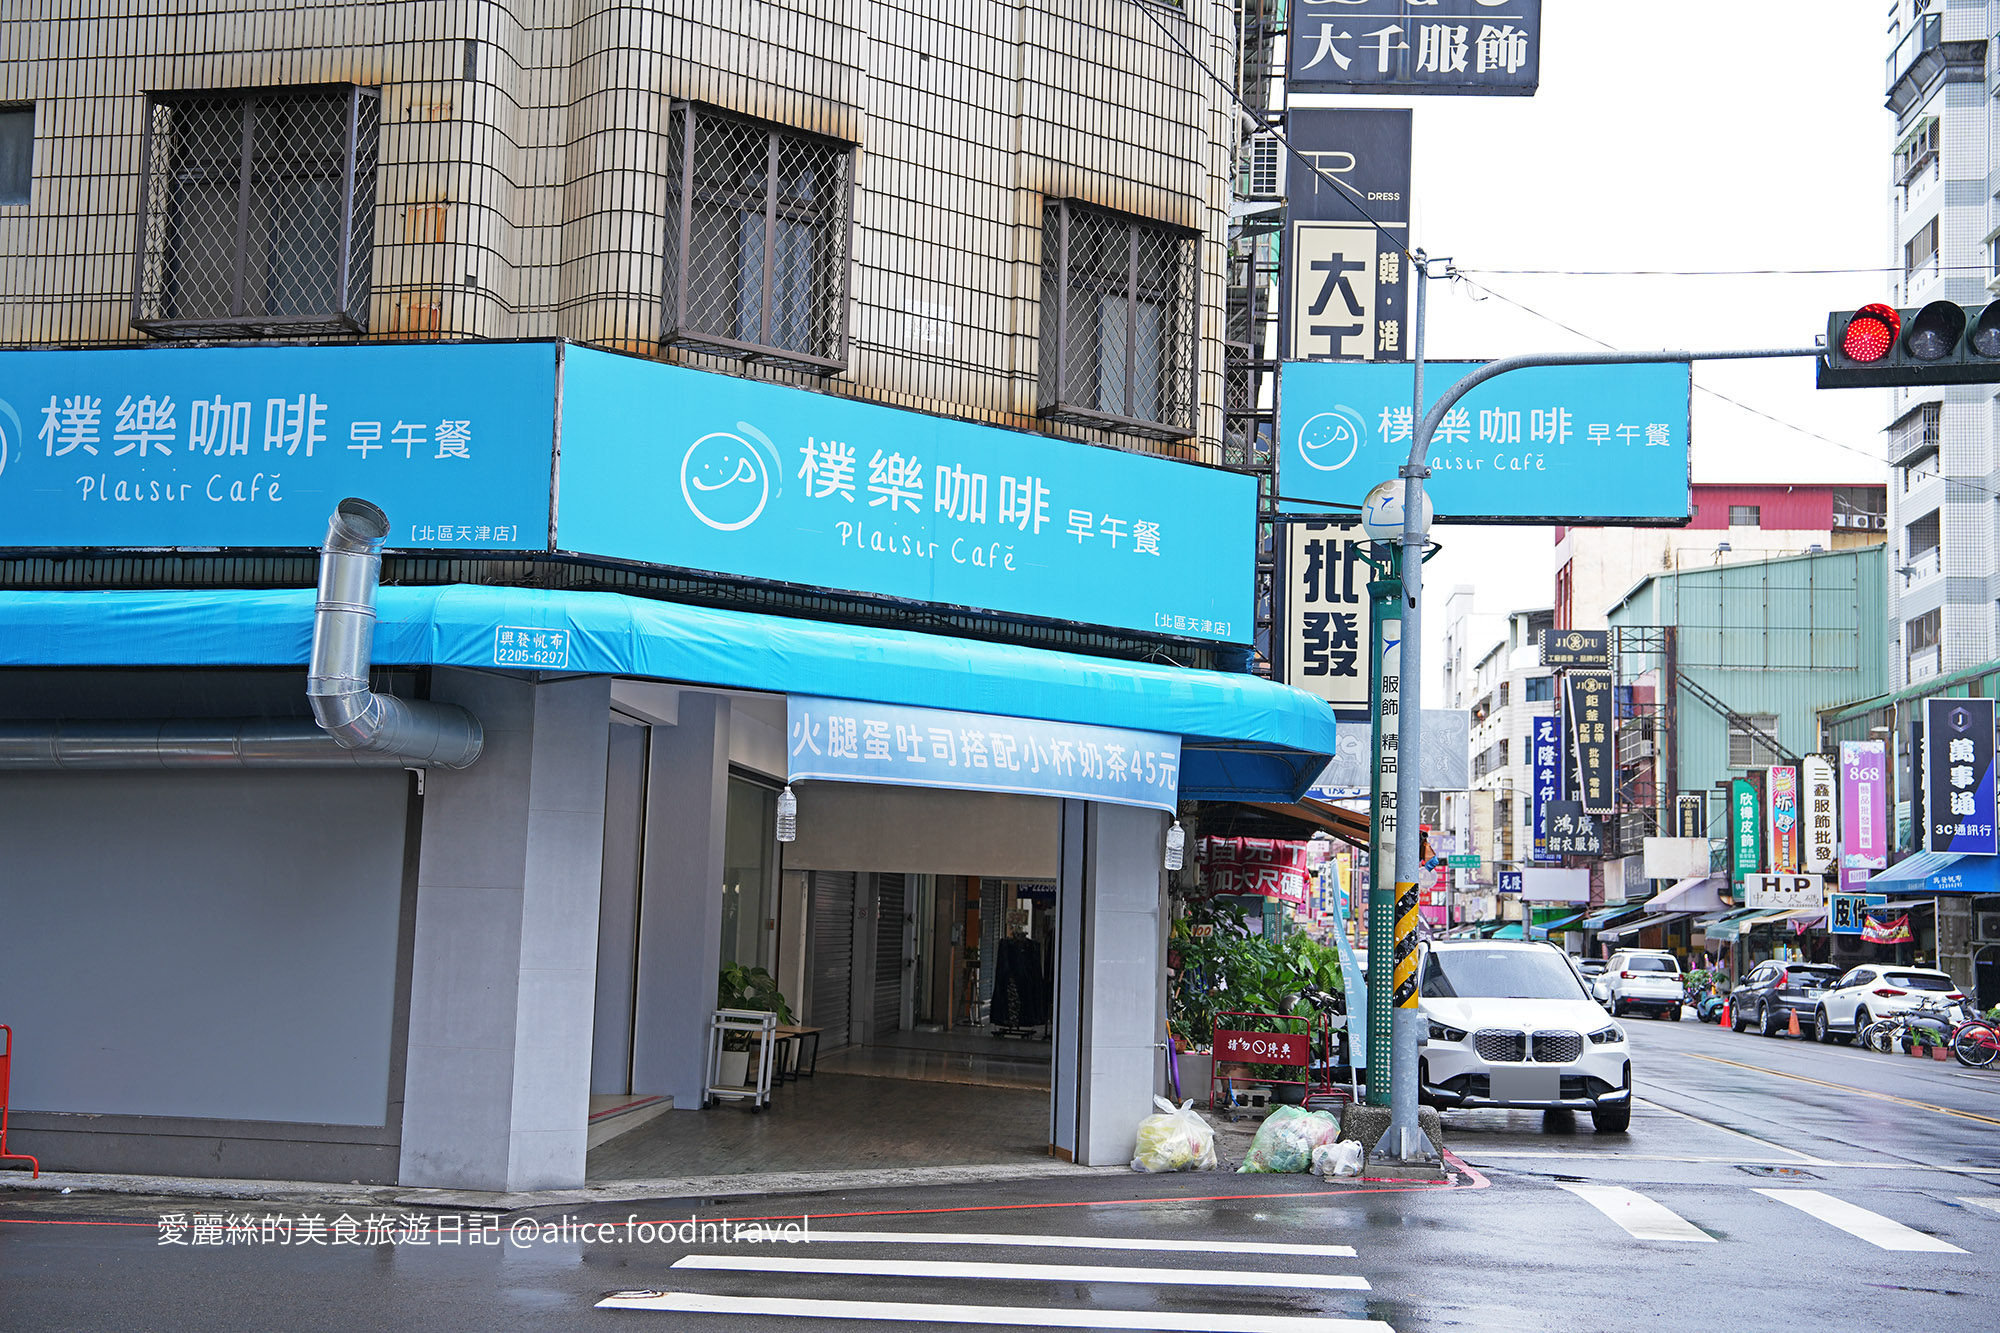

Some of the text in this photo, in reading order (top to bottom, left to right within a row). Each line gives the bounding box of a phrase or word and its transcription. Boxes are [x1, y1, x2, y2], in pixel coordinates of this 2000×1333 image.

[1300, 22, 1529, 74] 大千服飾
[1297, 150, 1366, 199] R
[1367, 191, 1401, 201] DRESS
[37, 393, 472, 461] 樸樂咖啡 早午餐
[1376, 405, 1672, 448] 樸樂咖啡 早午餐
[75, 467, 193, 502] Plaisir
[797, 436, 1162, 557] 樸樂咖啡 早午餐
[834, 520, 938, 560] Plaisir
[498, 649, 565, 665] 2205-6297
[499, 630, 565, 650] 興發帆布
[1381, 675, 1399, 717] 服飾
[792, 710, 1178, 792] 火腿蛋吐司搭配小杯奶茶45元
[1381, 733, 1399, 775] 精品
[1849, 767, 1880, 782] 868
[1949, 738, 1976, 816] 萬事通
[1380, 791, 1398, 833] 配件
[1812, 767, 1832, 861] 三鑫服飾批發
[1935, 823, 1993, 838] 3C通訊行
[1501, 875, 1523, 891] 元隆
[1761, 877, 1811, 893] H.P
[1834, 898, 1868, 928] 皮件
